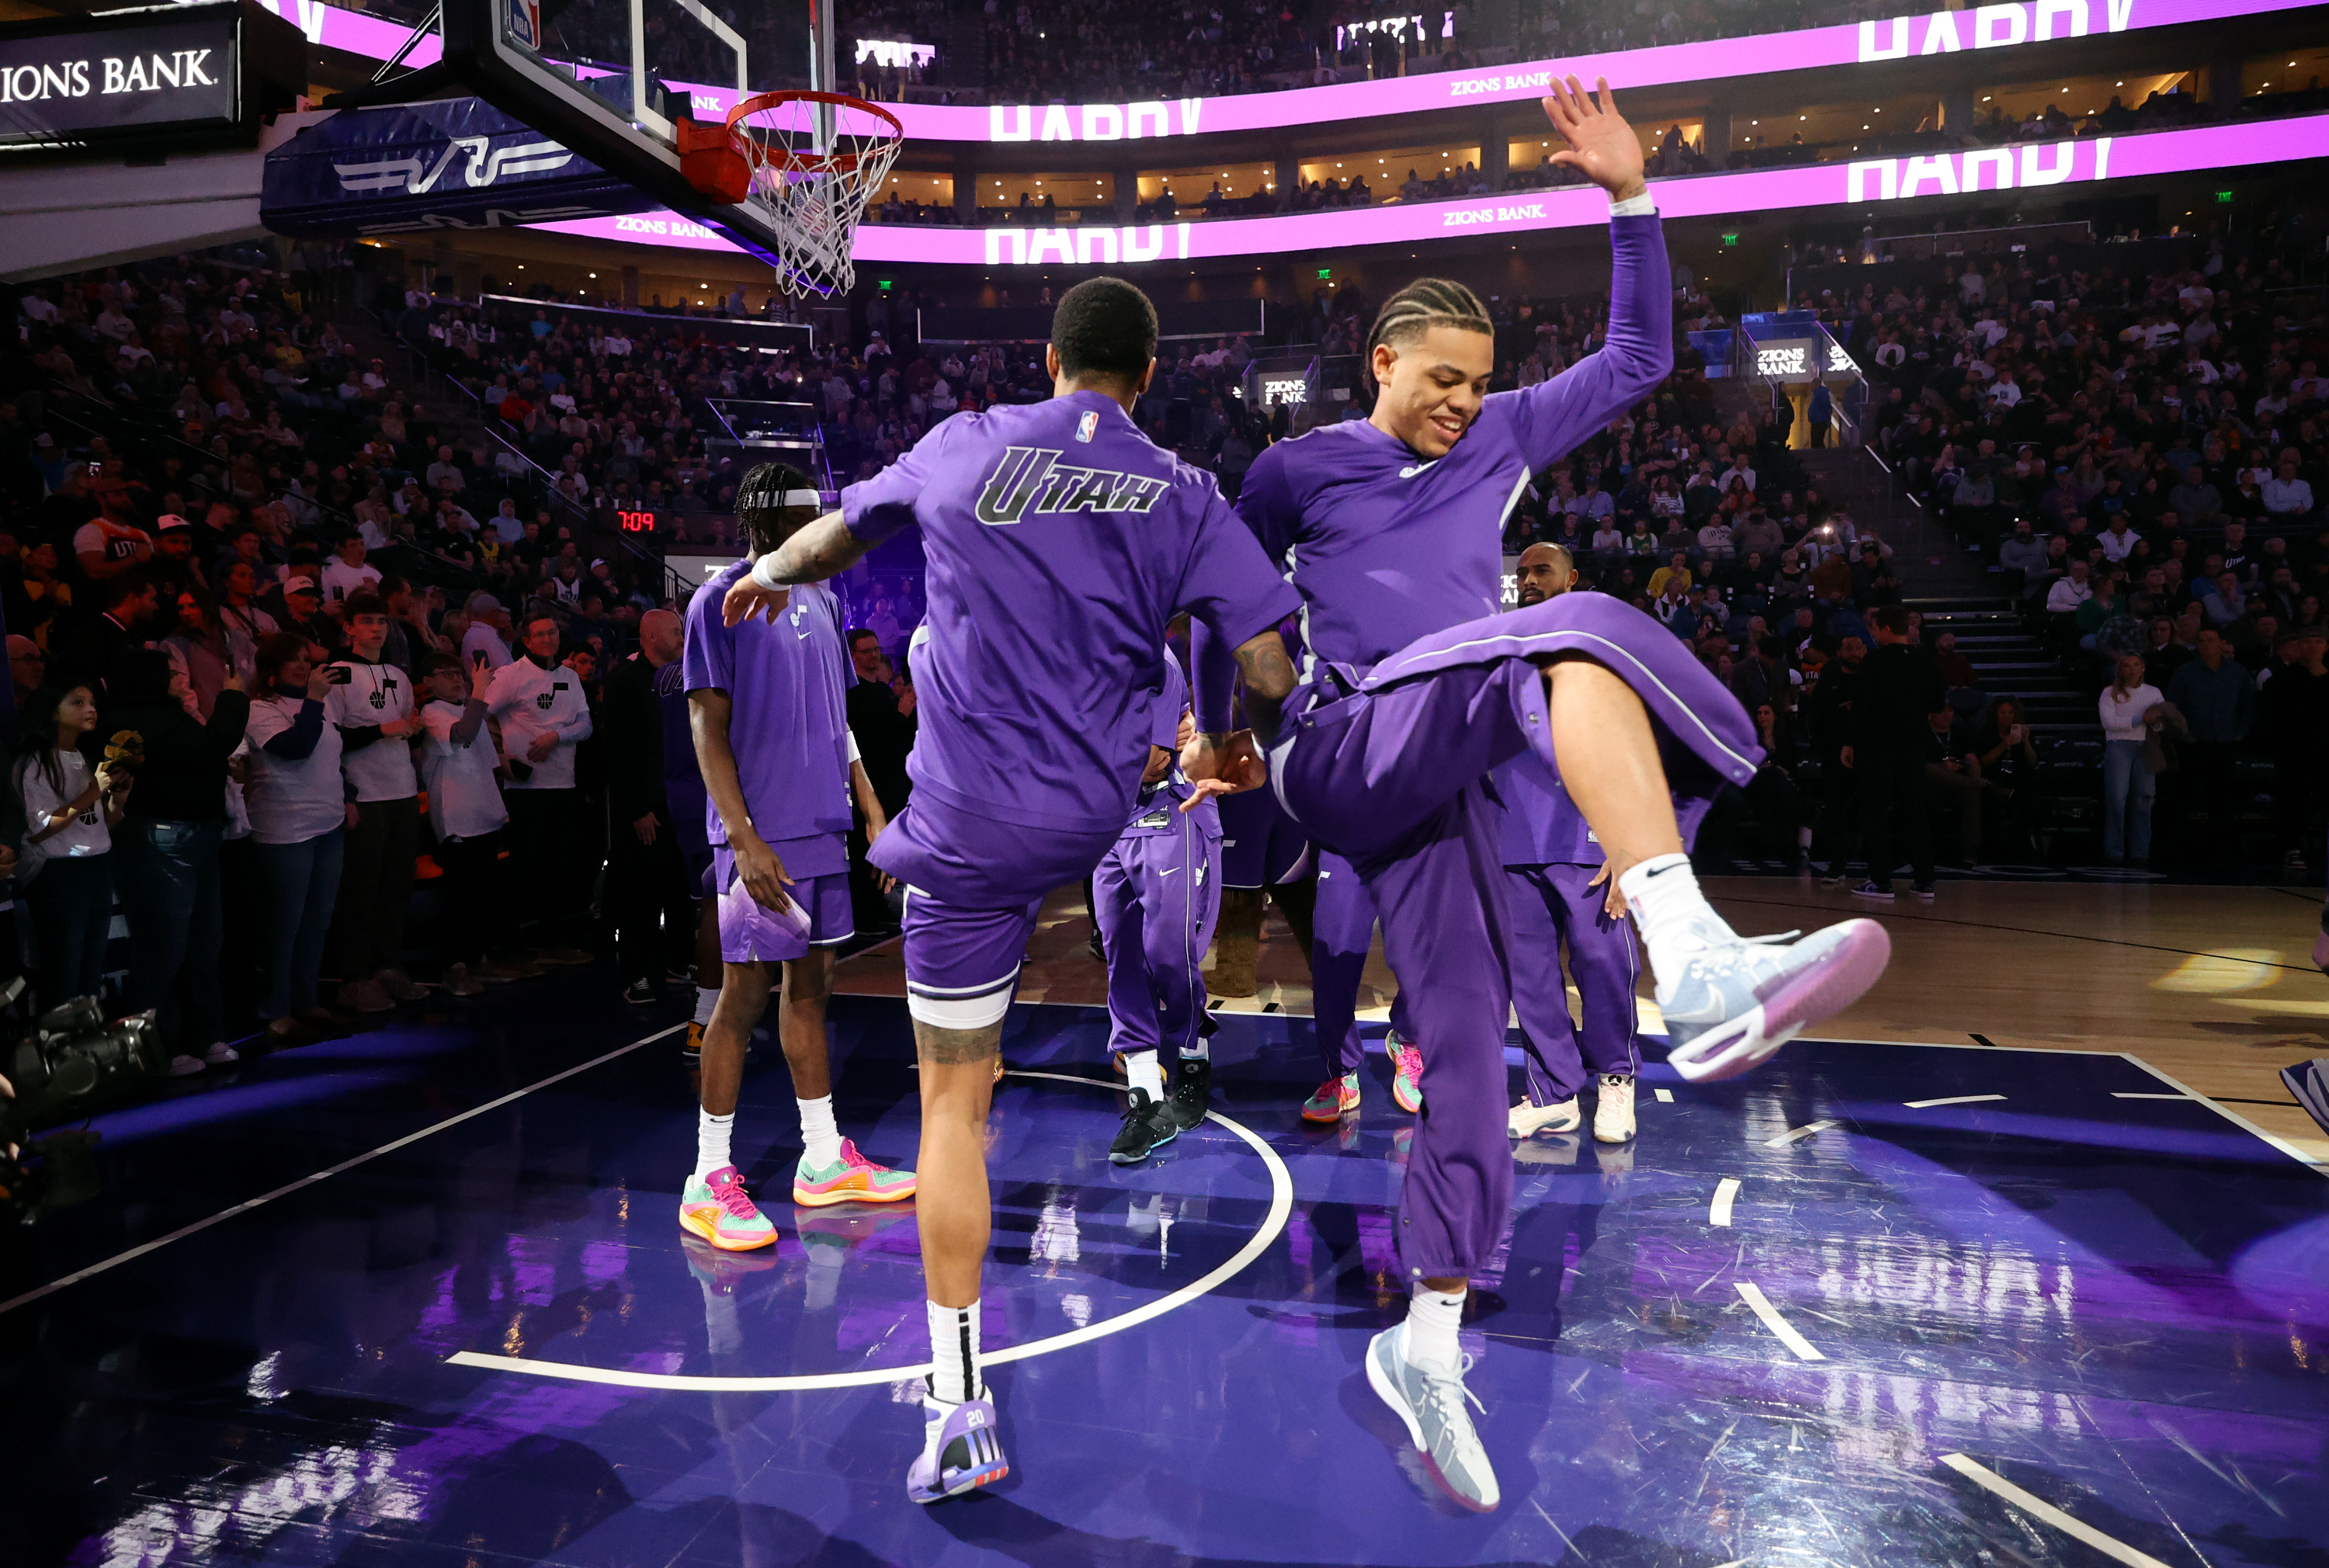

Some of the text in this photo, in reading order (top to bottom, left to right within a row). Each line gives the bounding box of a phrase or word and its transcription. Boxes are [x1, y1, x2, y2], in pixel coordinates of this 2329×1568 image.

[513, 13, 529, 39] NBA
[1450, 77, 1501, 95] ZIONS
[615, 216, 667, 234] ZIONS
[1443, 209, 1494, 226] ZIONS
[1758, 347, 1805, 363] ZIONS
[1265, 380, 1306, 393] ZIONS
[975, 446, 1171, 526] UTAH
[618, 511, 654, 532] 7:09
[966, 1408, 985, 1428] 20
